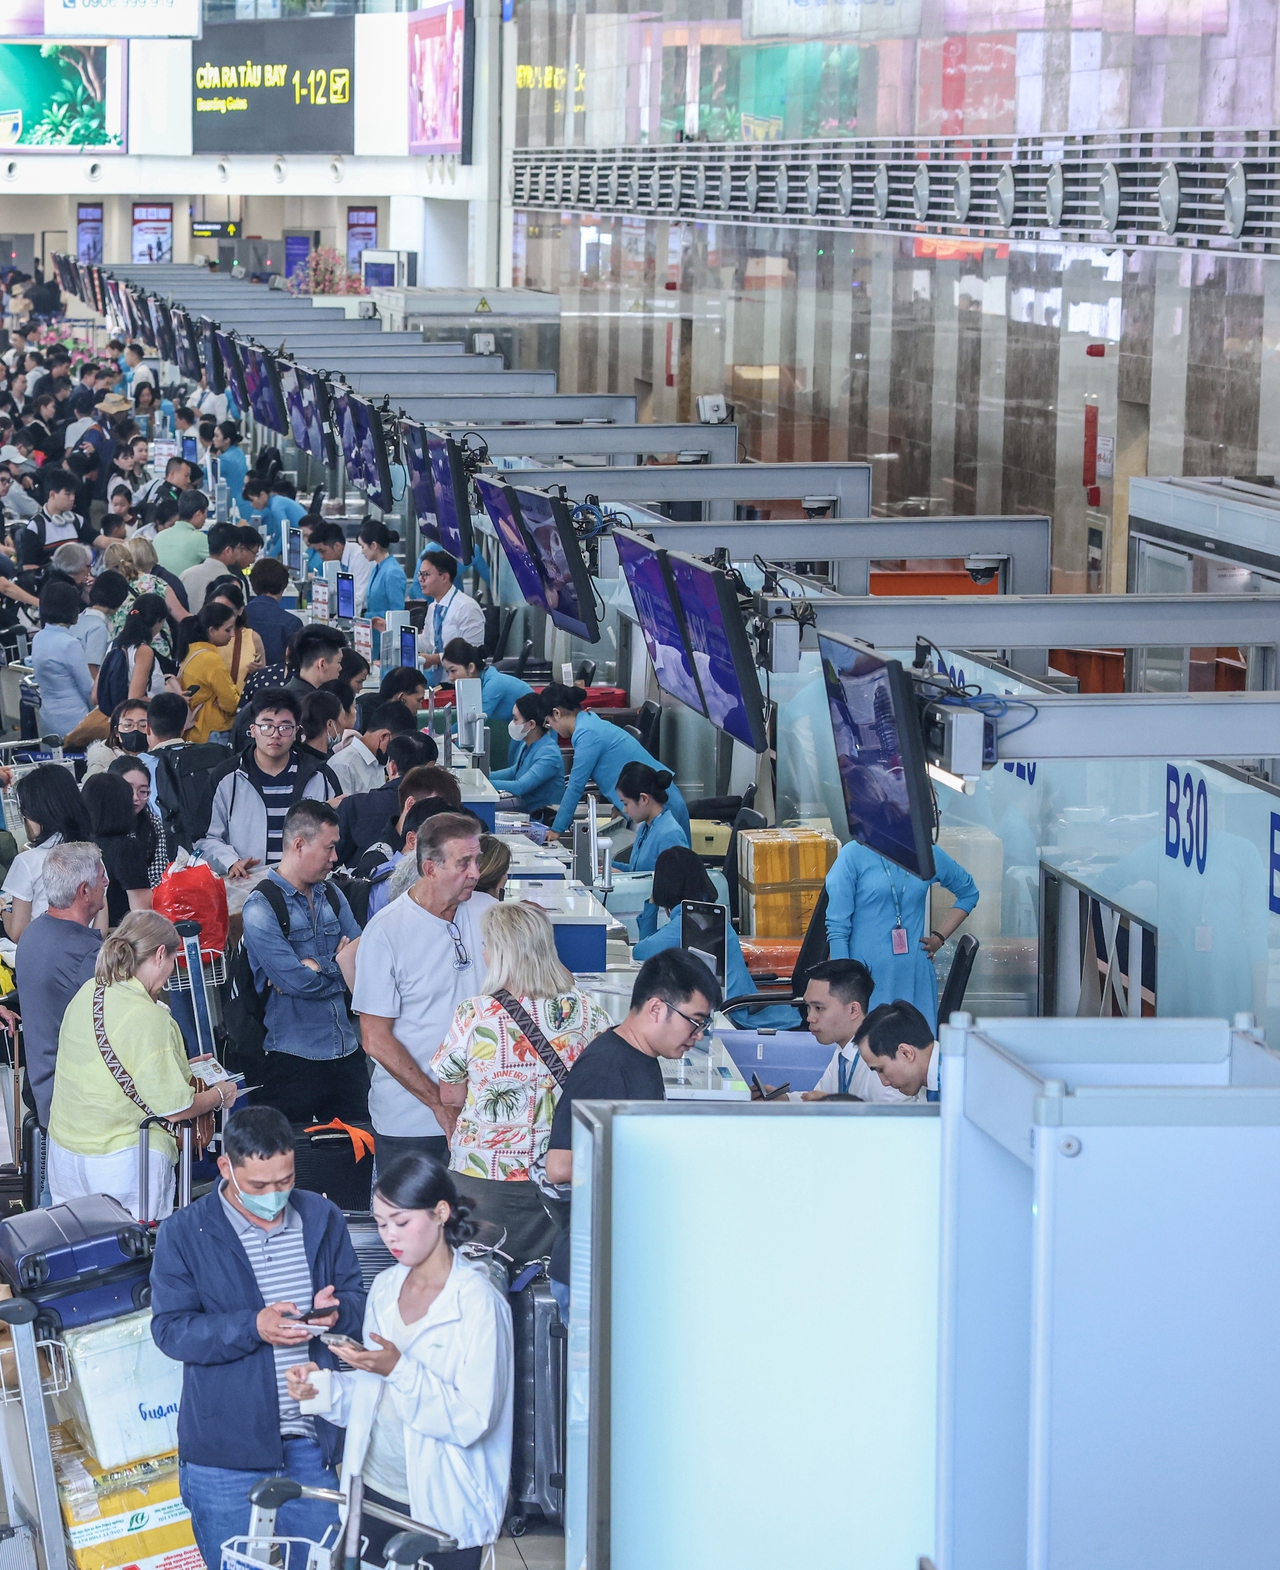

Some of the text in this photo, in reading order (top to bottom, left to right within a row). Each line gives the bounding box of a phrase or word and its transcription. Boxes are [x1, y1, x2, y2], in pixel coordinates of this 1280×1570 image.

[221, 66, 238, 88] RA
[264, 64, 287, 87] BAY
[292, 69, 327, 105] 1-12
[1166, 762, 1209, 875] B30
[491, 1069, 528, 1083] JANEIRO
